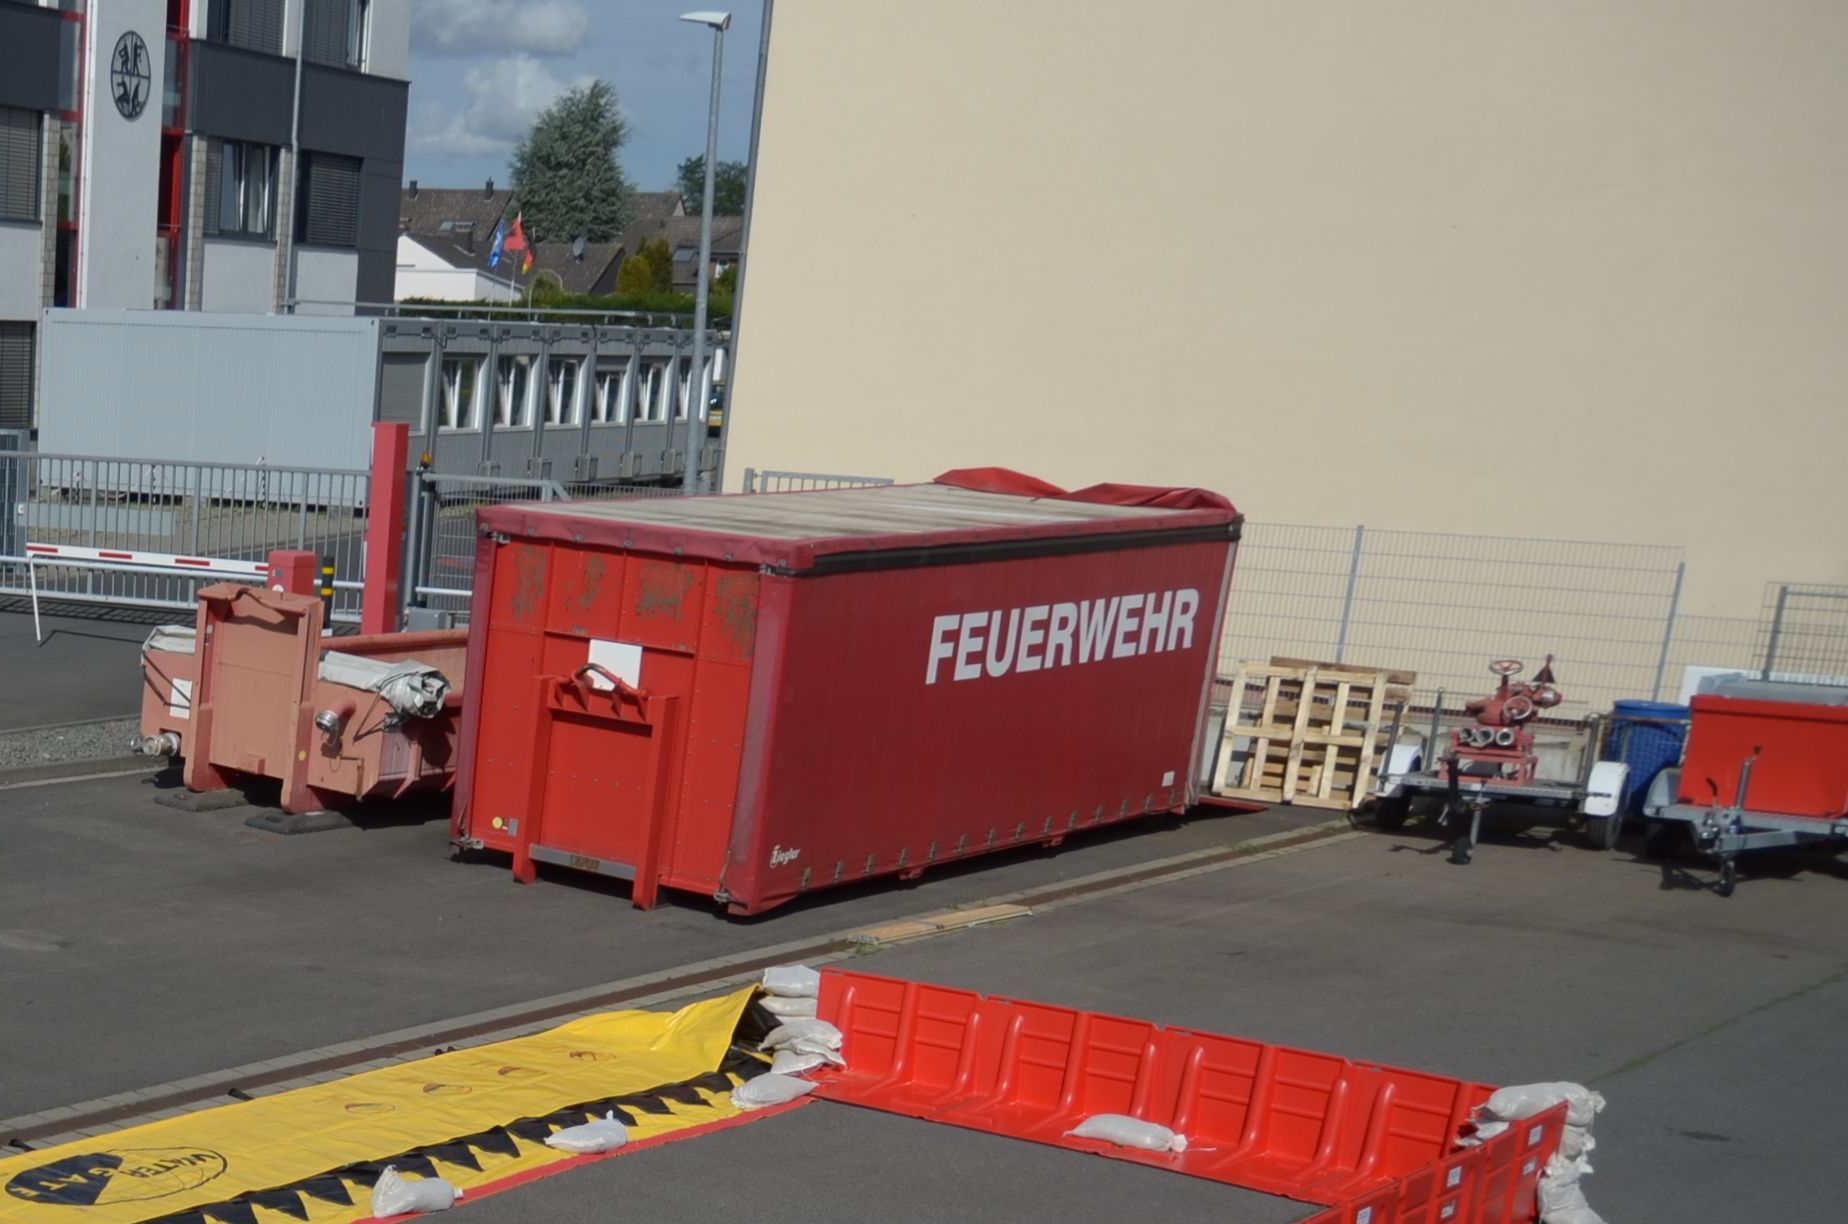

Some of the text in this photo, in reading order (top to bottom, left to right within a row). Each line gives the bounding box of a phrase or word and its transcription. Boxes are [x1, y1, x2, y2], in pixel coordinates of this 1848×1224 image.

[925, 588, 1199, 685] FEUERWEHR
[119, 1152, 218, 1179] WATER
[9, 1166, 113, 1198] GATE
